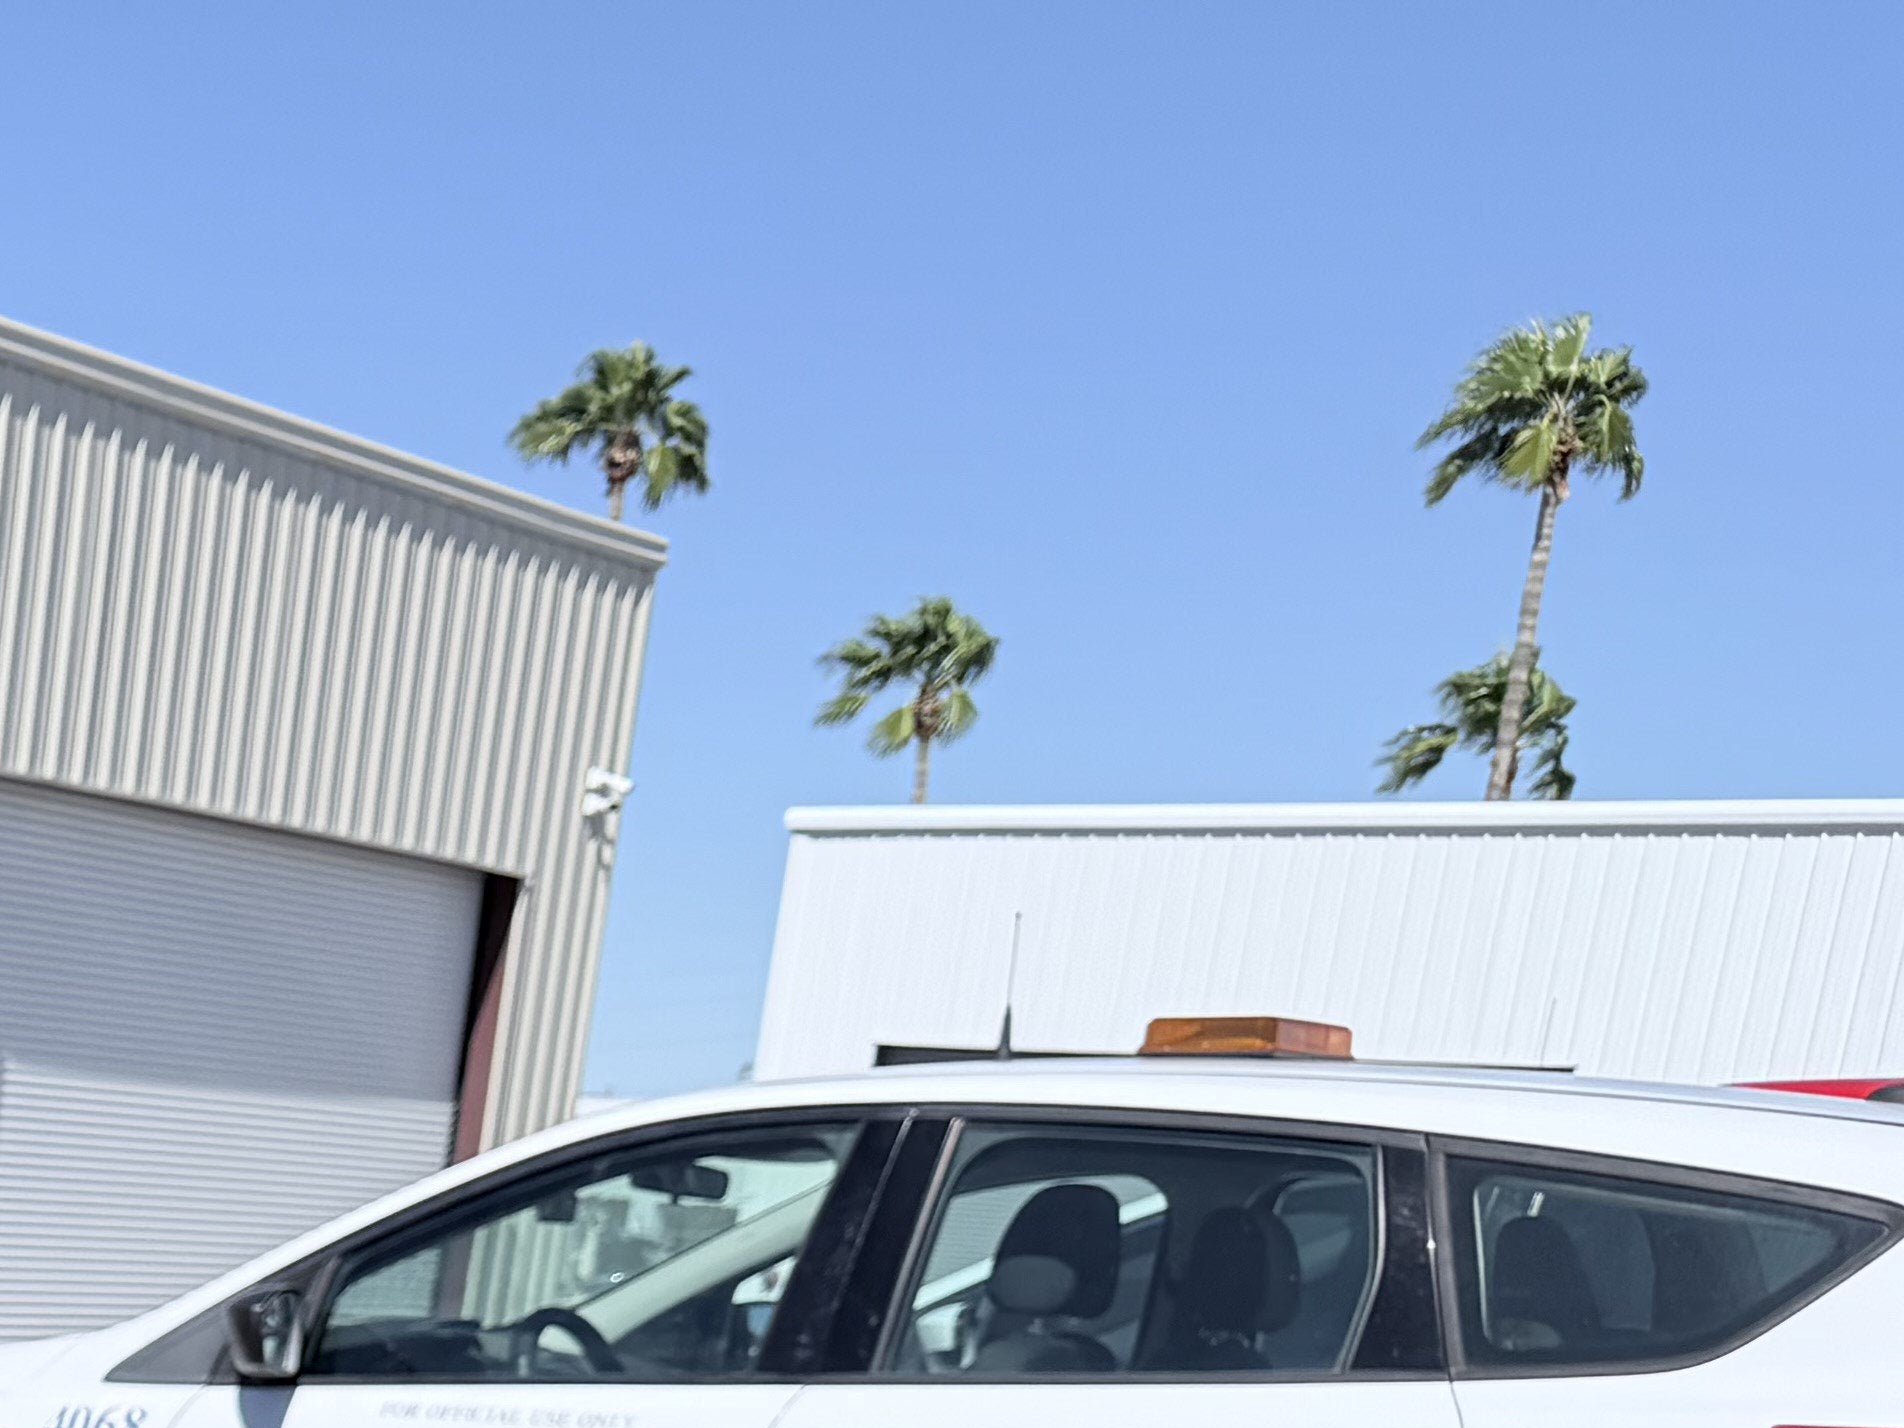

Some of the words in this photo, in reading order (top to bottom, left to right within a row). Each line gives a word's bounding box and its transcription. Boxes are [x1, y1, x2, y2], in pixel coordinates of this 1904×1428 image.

[379, 1401, 418, 1419] FOR
[425, 1404, 519, 1425] OFFICIAL
[529, 1408, 569, 1427] USE
[577, 1410, 636, 1428] ONLY
